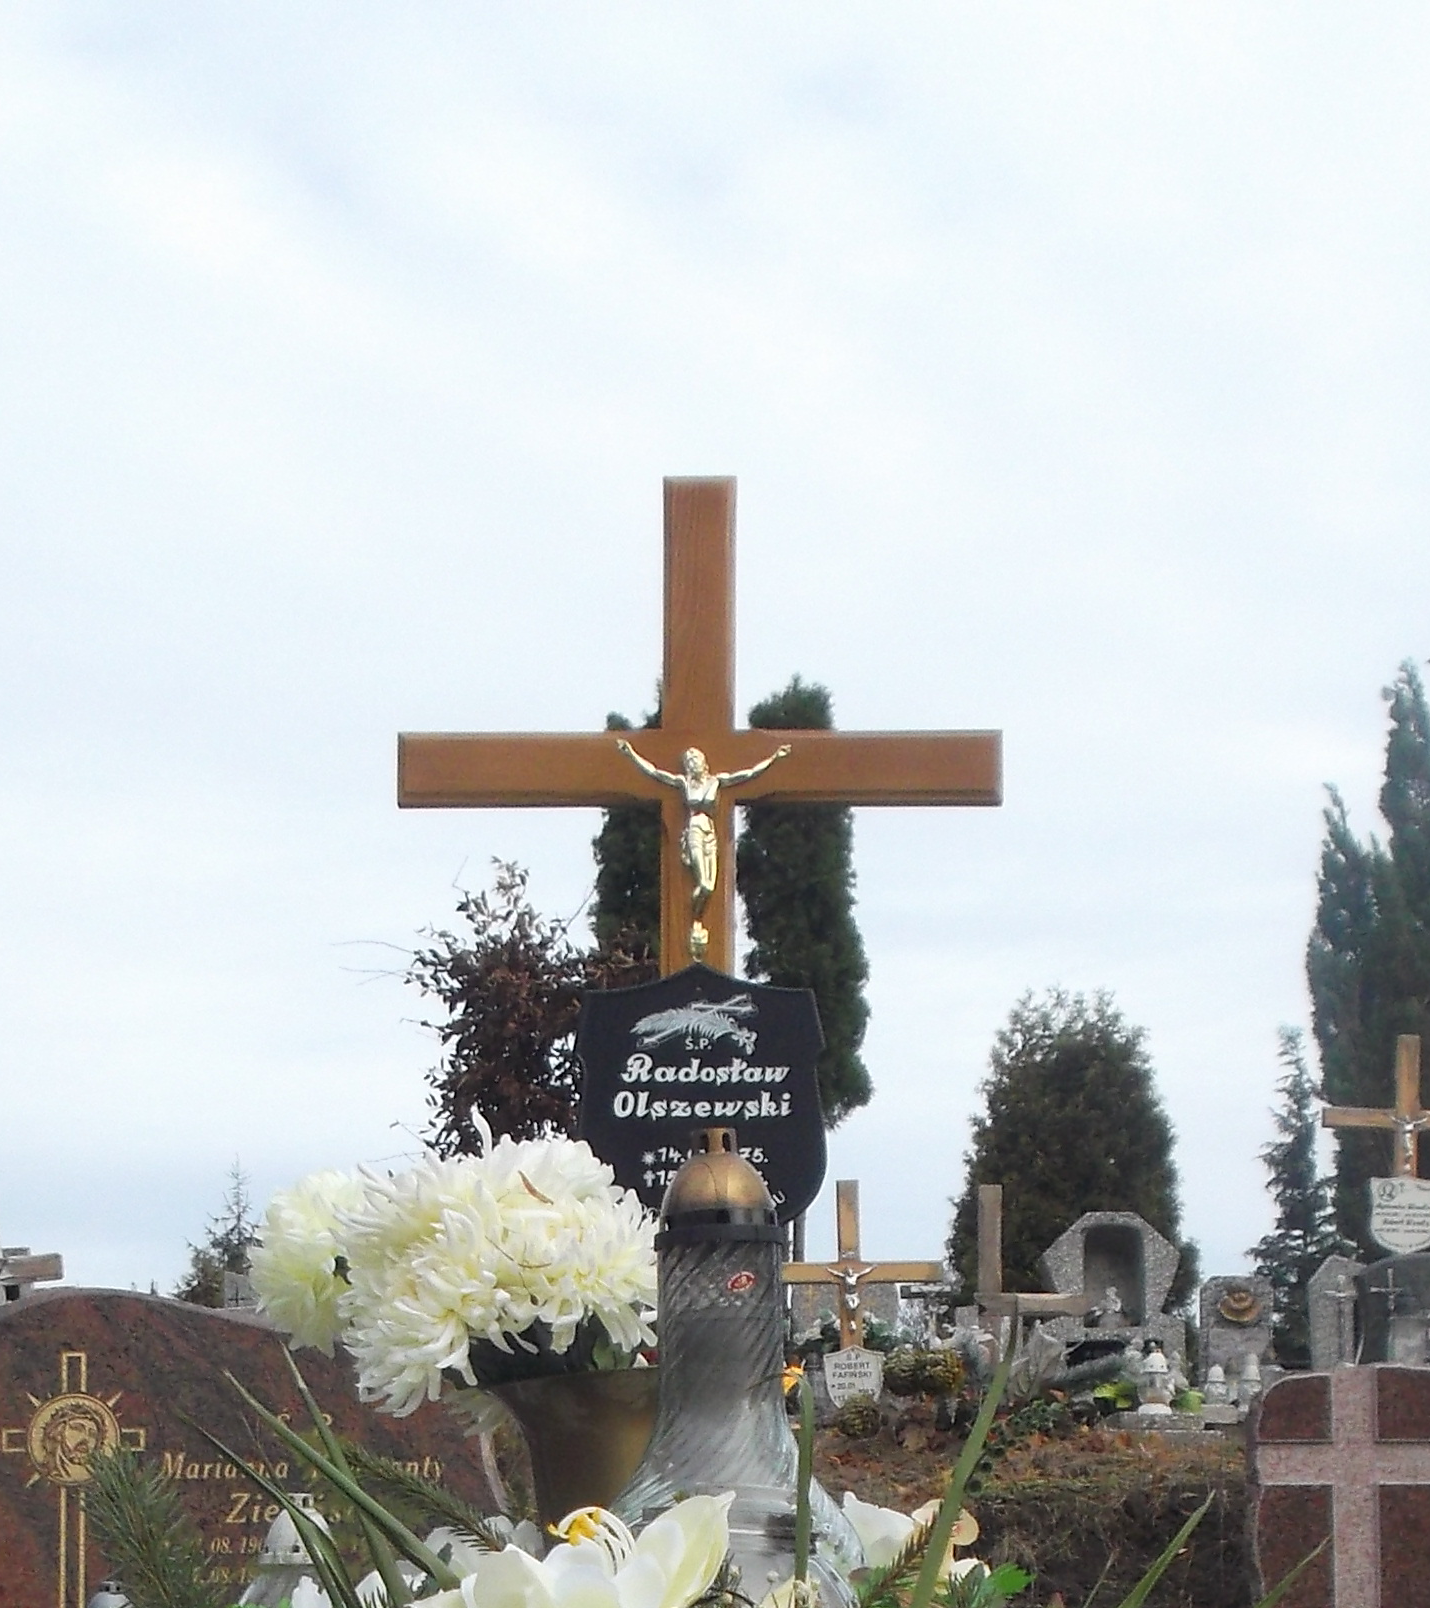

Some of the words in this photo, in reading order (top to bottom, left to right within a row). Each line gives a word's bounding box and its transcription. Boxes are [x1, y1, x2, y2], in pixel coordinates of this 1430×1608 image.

[620, 1053, 790, 1086] Radosław
[613, 1090, 792, 1121] Olszewski
[833, 1361, 870, 1370] ROBERT
